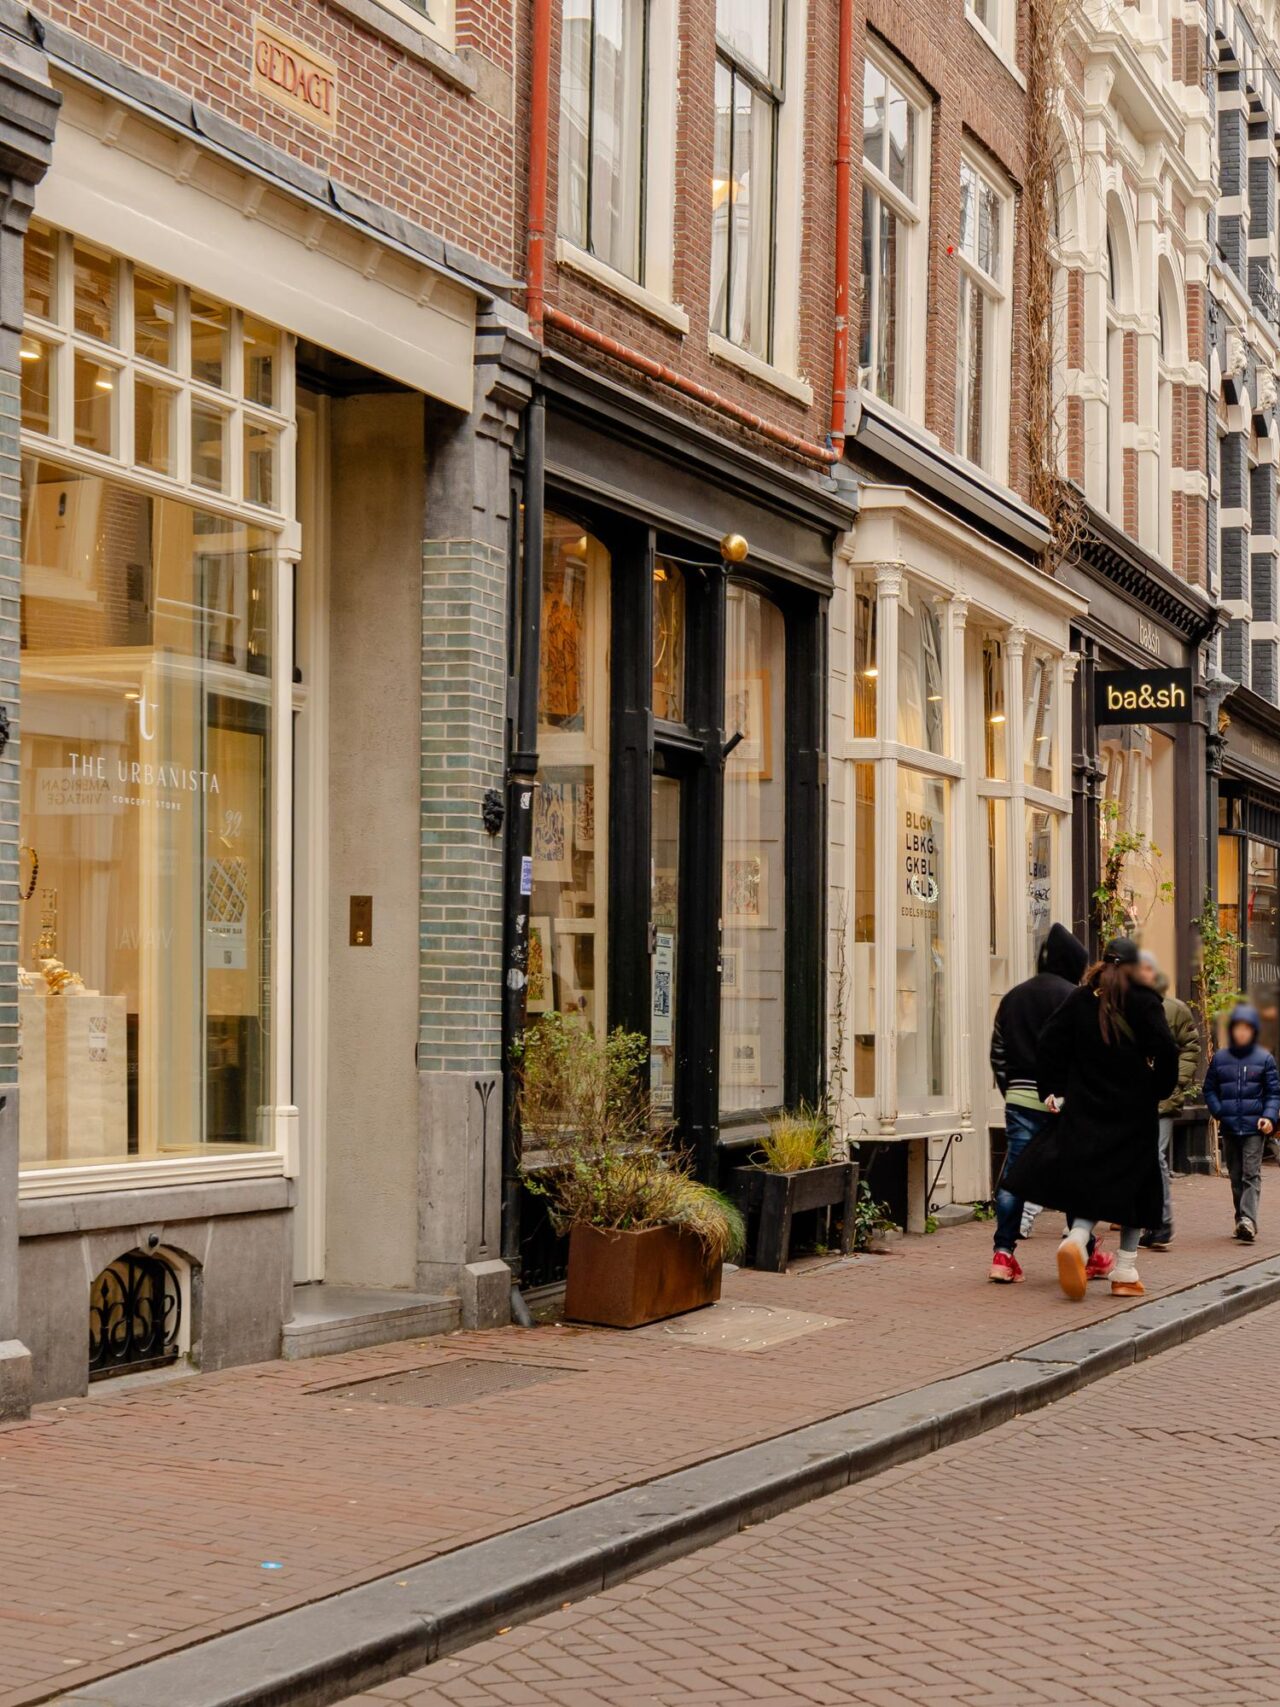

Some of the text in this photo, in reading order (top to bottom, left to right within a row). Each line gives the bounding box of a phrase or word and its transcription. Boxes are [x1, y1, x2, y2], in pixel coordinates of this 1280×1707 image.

[255, 40, 335, 116] GEDAGT
[1139, 617, 1160, 655] ba&sh
[1107, 683, 1185, 710] ba&sh
[69, 752, 220, 794] THE URBANISTA
[112, 795, 151, 807] CONCEPT
[906, 811, 933, 833] BLGK
[906, 834, 934, 854] LBKG
[905, 856, 934, 877] GKBL
